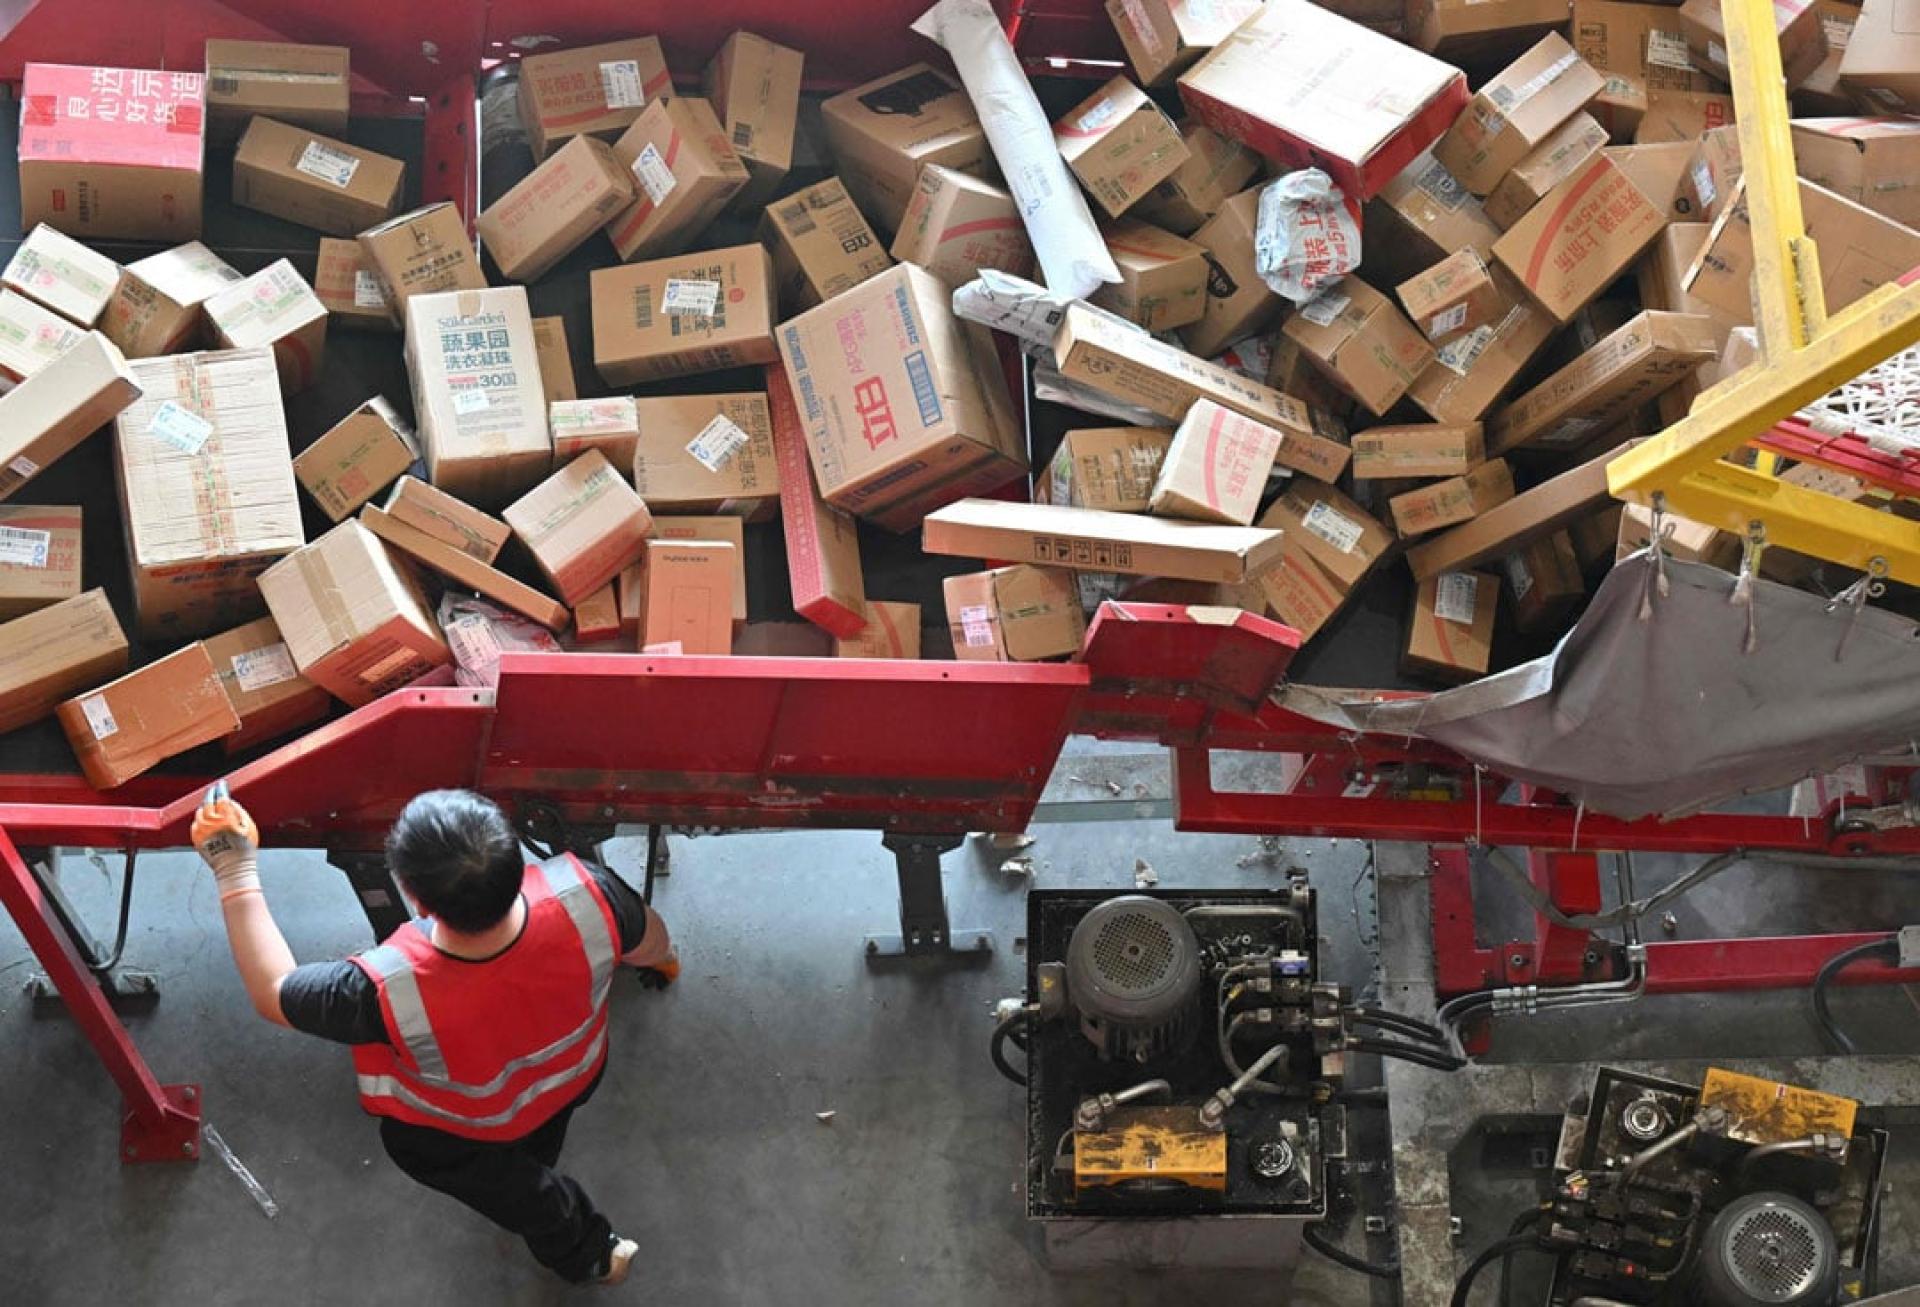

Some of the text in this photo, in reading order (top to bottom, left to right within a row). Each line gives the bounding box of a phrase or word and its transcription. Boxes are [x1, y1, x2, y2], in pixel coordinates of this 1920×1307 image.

[92, 69, 201, 101] 选京造
[68, 96, 177, 125] 良心好货
[441, 331, 509, 352] 蔬果园
[855, 376, 898, 451] 立白
